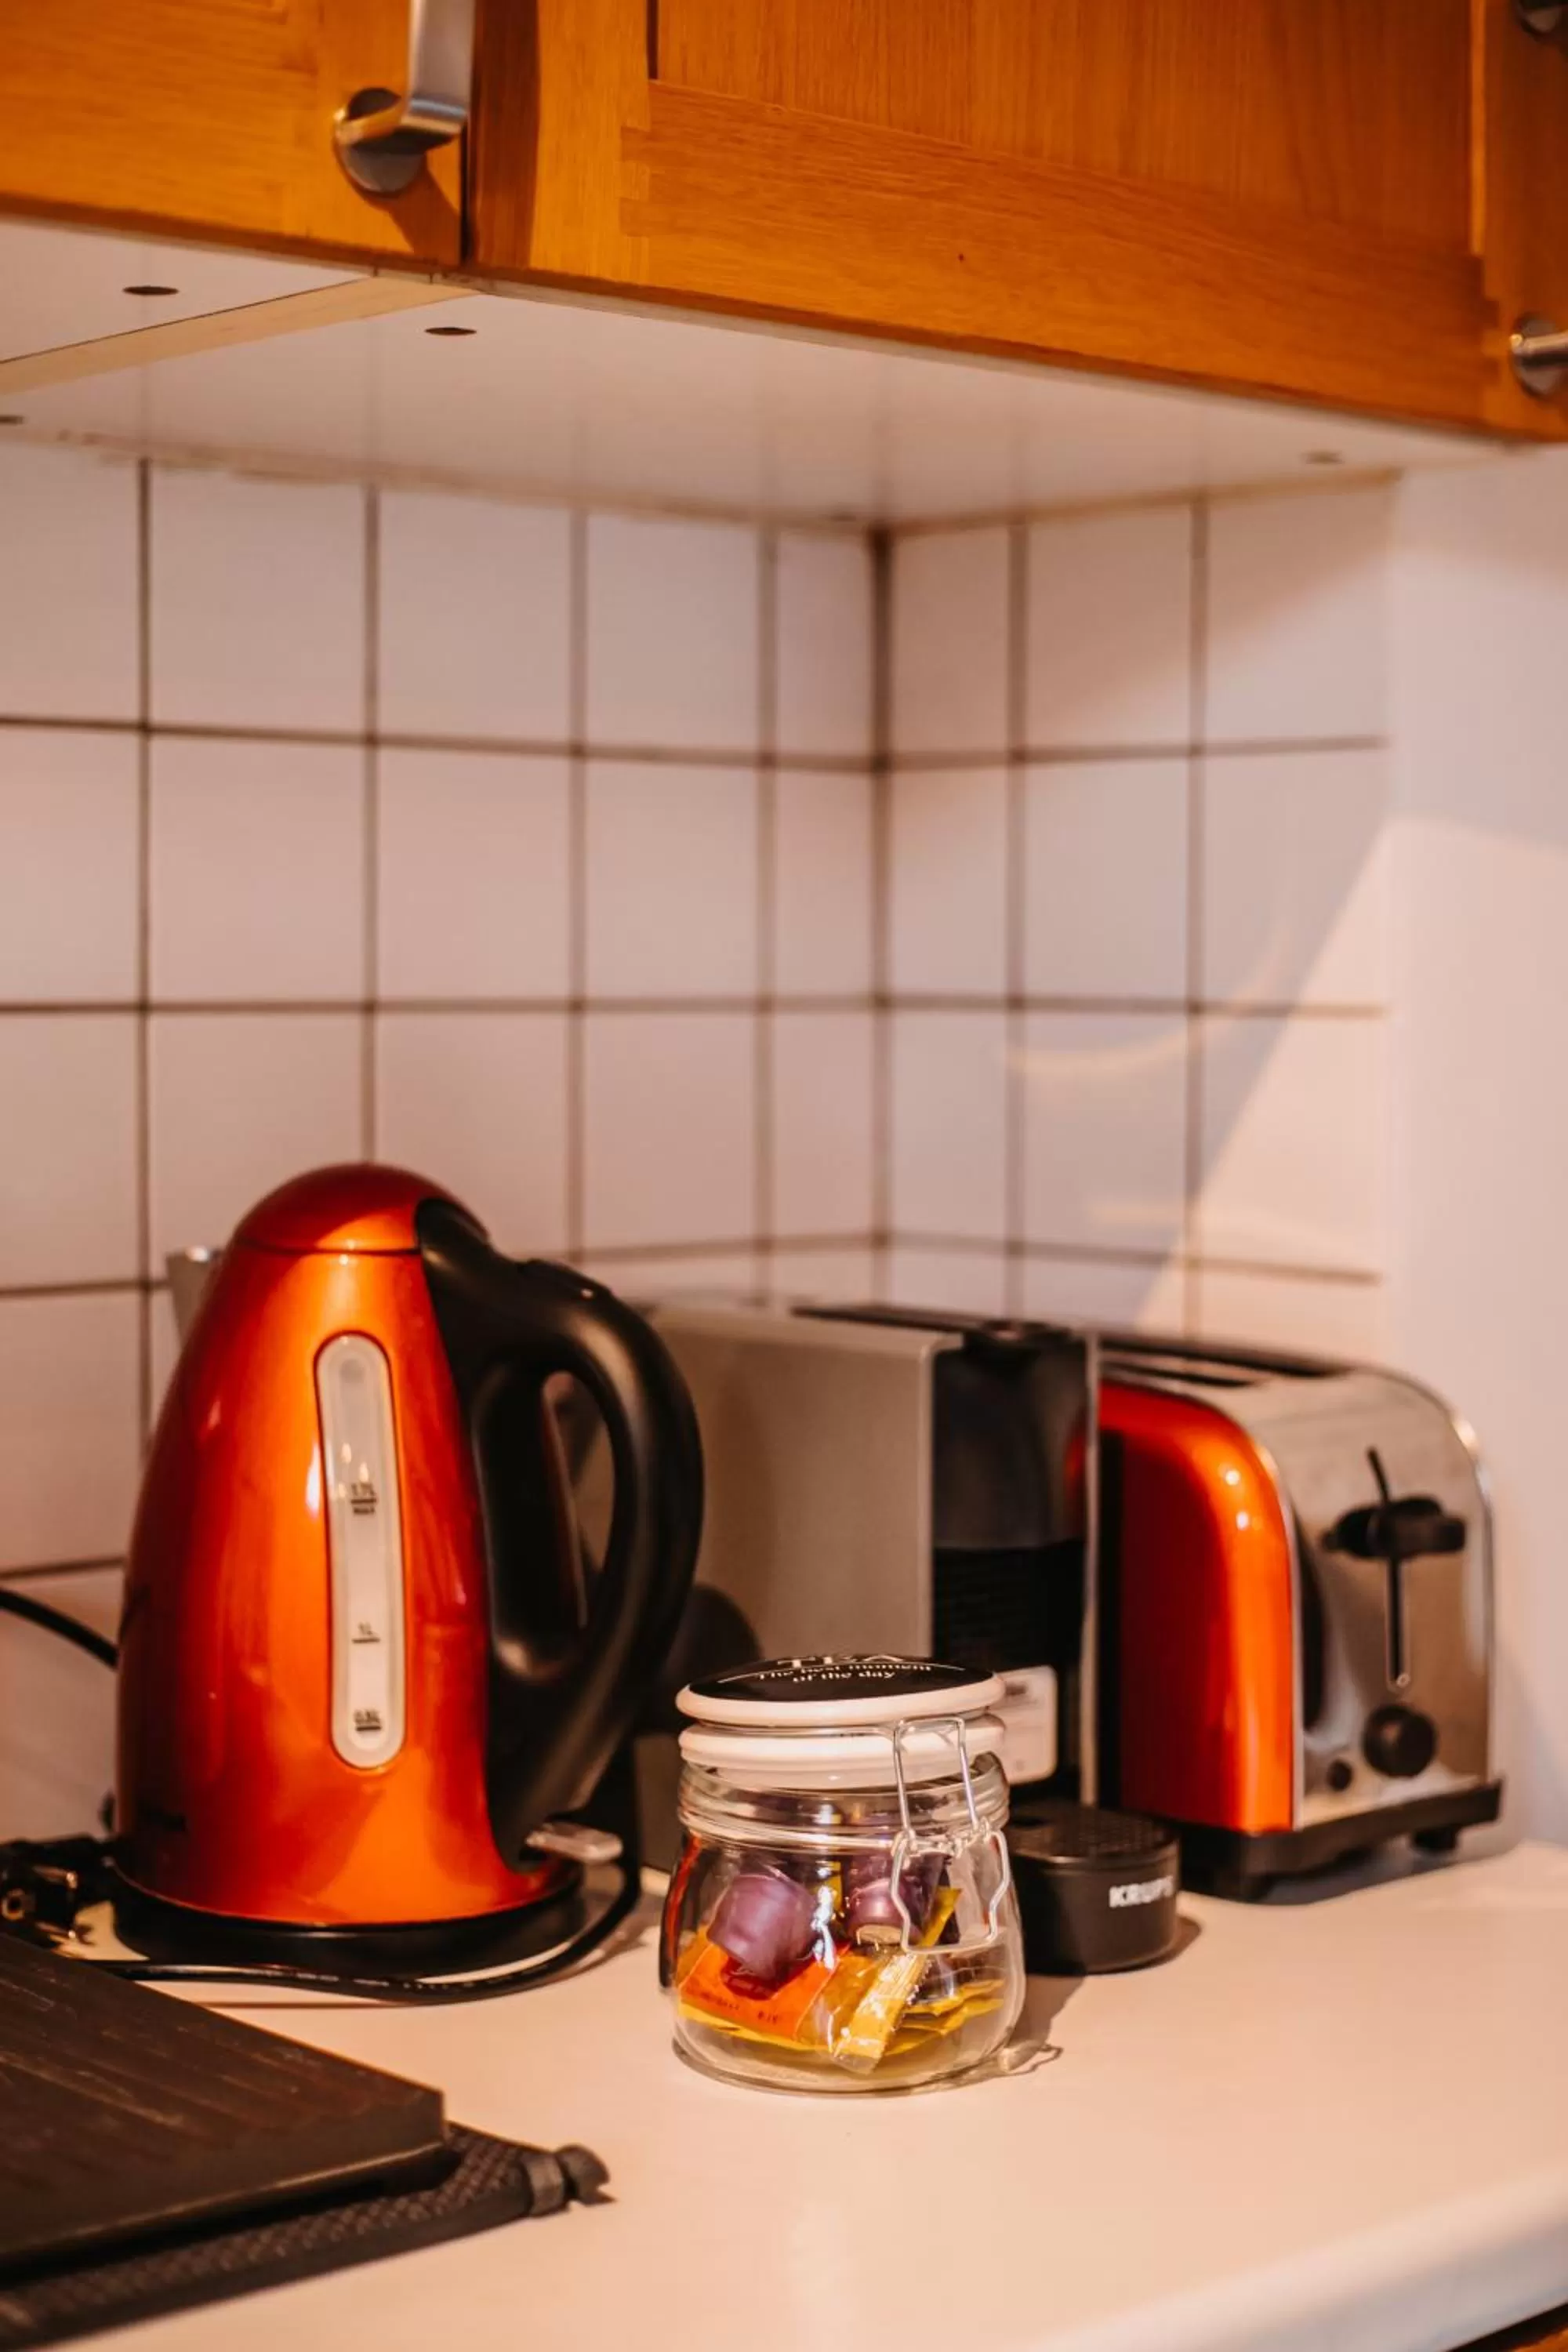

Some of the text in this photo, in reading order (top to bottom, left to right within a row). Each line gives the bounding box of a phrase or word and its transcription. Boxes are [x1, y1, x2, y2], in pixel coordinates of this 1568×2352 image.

[759, 1671, 794, 1680] The
[848, 1664, 931, 1672] moment
[793, 1670, 895, 1682] of the day
